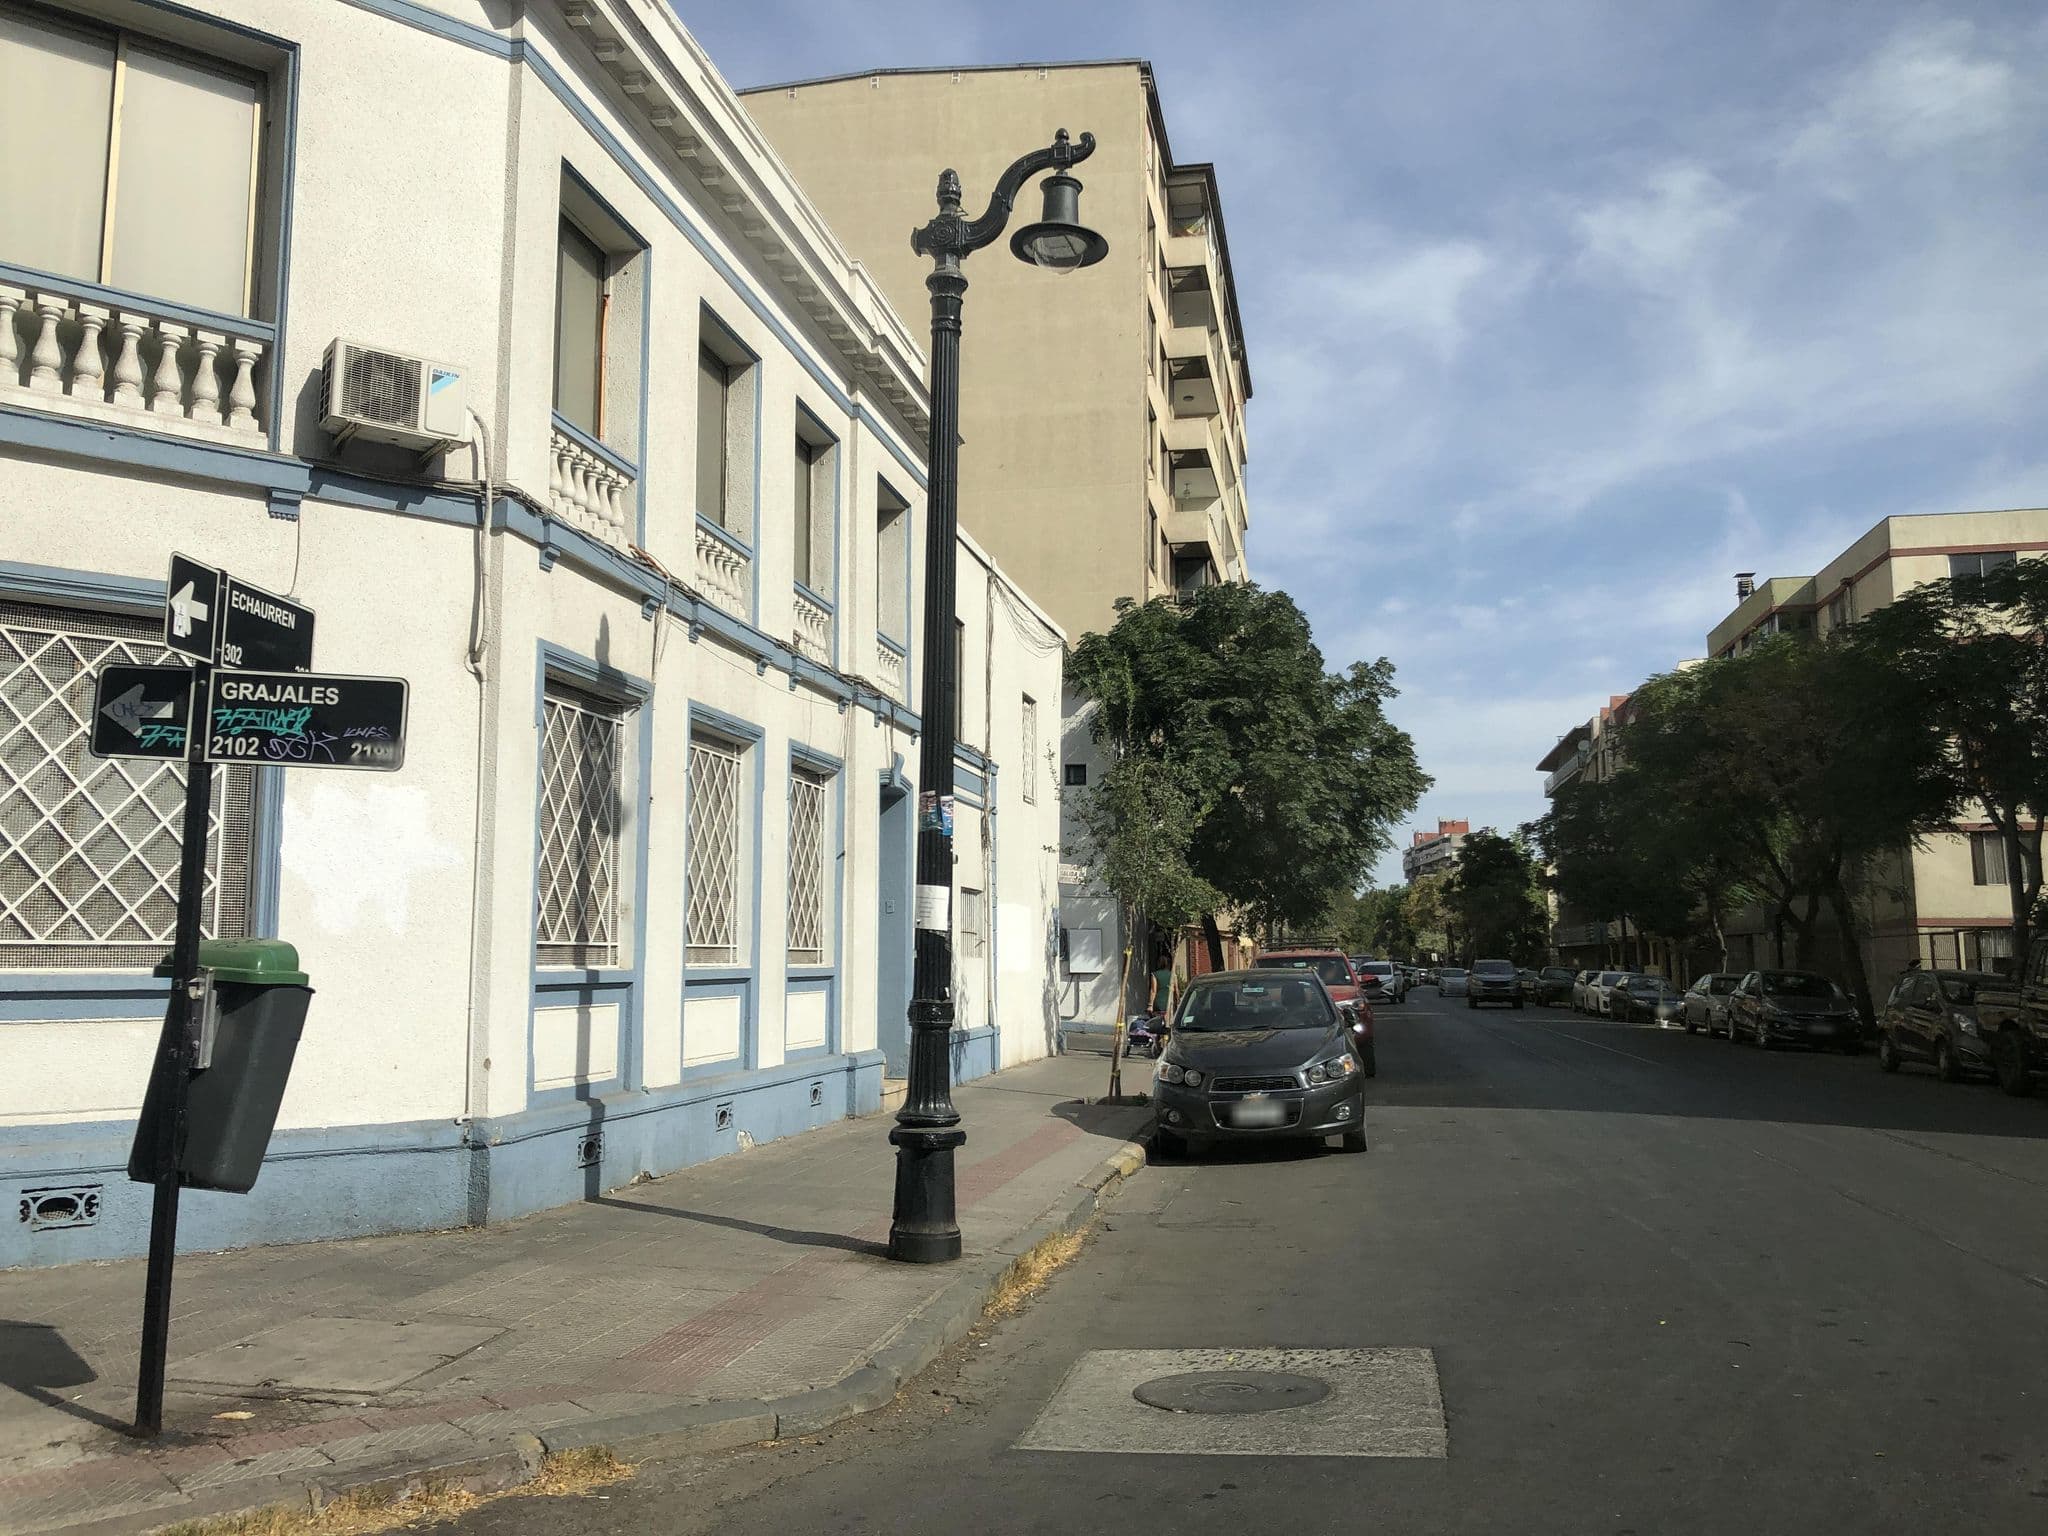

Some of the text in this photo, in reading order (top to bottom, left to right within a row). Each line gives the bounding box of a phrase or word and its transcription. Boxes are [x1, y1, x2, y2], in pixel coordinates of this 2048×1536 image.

[231, 590, 296, 630] ECHAURREN
[224, 643, 243, 665] 302
[221, 682, 340, 706] GRAJALES
[210, 736, 260, 756] 2102
